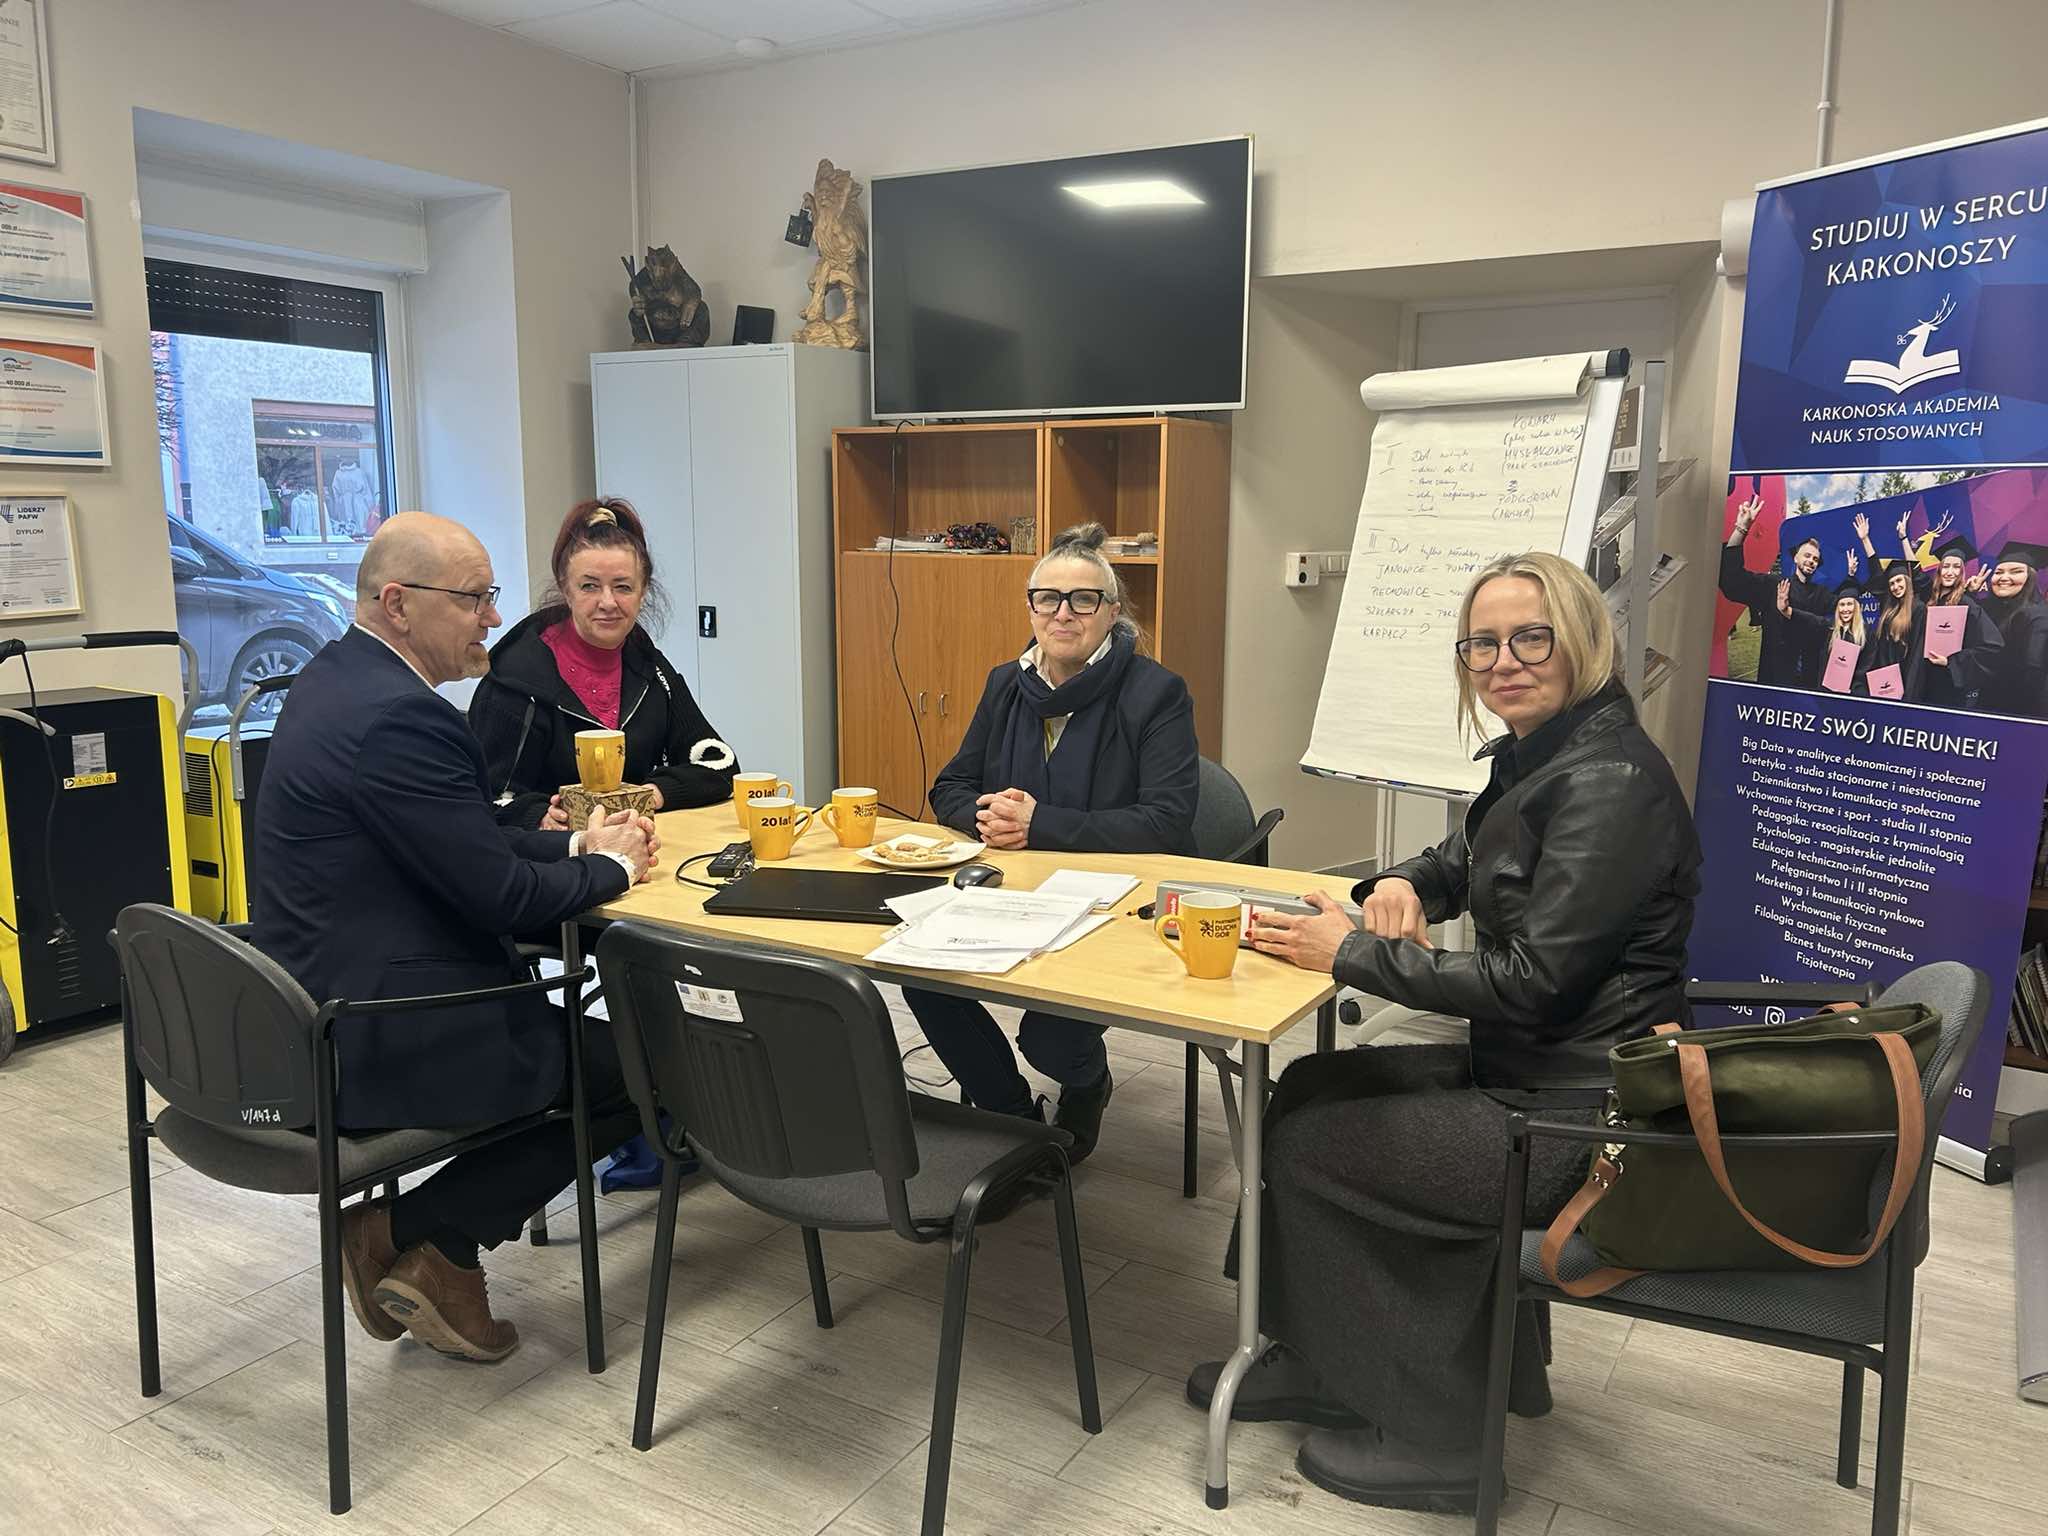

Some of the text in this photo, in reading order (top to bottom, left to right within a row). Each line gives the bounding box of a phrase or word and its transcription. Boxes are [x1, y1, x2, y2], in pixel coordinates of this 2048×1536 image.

[1810, 186, 2048, 251] STUDIUJ W SERCU
[1827, 235, 2017, 286] KARKONOSZY
[1802, 395, 2000, 422] KARKONOSKA AKADEMIA
[1811, 421, 1983, 444] NAUK STOSOWANYCH
[1737, 704, 1998, 760] WYBIERZ SWÓJ KIERUNEK!
[1742, 736, 1758, 750] Big
[1760, 739, 1784, 753] Data
[1797, 748, 1842, 763] analityce
[1844, 754, 1917, 779] ekonomicznej
[1919, 768, 1924, 778] i
[1926, 770, 1986, 792] społecznej
[1742, 753, 1786, 770] Dietetyka
[1795, 765, 1825, 778] studia
[1827, 770, 1889, 790] stacjonarne
[1891, 781, 1896, 791] i
[1899, 784, 1982, 808] niestacjonarne
[748, 789, 775, 799] 20 lat
[1736, 784, 1793, 805] Wychowanie
[1795, 796, 1835, 815] fizyczne
[1837, 807, 1842, 817] i
[1844, 809, 1871, 822] sport
[1881, 817, 1916, 832] studia
[1930, 828, 1972, 844] stopnia
[1752, 771, 1955, 822] Dziennikarstwo i komunikacja społeczna
[761, 816, 791, 827] 20 lat
[1752, 804, 1965, 865] Pedagogika: resocjalizacja z kryminologią
[1752, 837, 1930, 891] Edukacja techniczno-informatyczna
[1757, 822, 1811, 844] Psychologia
[1820, 840, 1886, 862] magisterskie
[1888, 854, 1937, 874] jednolite
[1755, 871, 1925, 928] Marketing i komunikacja rynkowa
[1771, 858, 1841, 887] Pielęgniarstwo
[1850, 880, 1855, 890] i
[1868, 887, 1908, 905] stopnia
[1754, 904, 1794, 926] Filologia
[1796, 920, 1844, 941] angielska
[1854, 937, 1915, 962] germańska
[1781, 895, 1887, 935] Wychowanie fizyczne
[1784, 930, 1874, 970] Biznes turystyczny
[1796, 951, 1856, 980] Fizjoterapia
